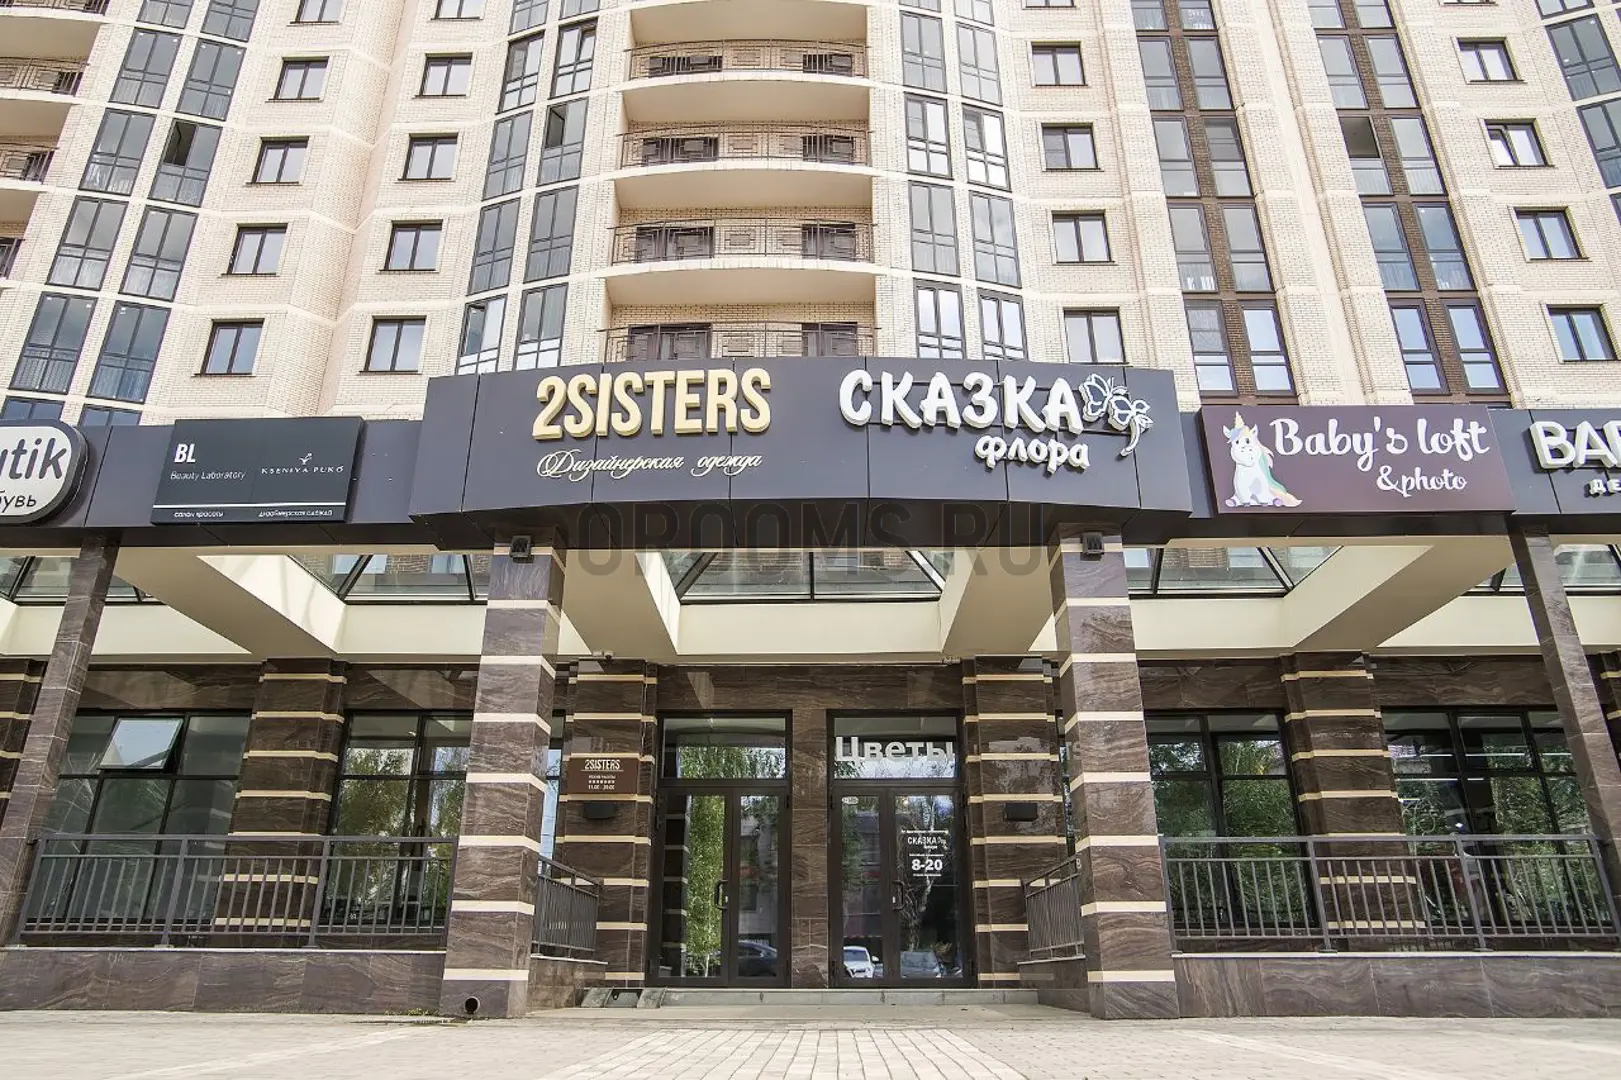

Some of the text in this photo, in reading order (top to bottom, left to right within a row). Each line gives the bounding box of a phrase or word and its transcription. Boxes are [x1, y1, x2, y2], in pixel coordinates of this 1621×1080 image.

[532, 368, 771, 440] 2SISTERS
[839, 369, 1084, 435] СКАЗКА
[0, 437, 67, 479] tik
[174, 443, 196, 463] BL
[974, 435, 1091, 474] флора
[1269, 416, 1490, 472] Baby's loft
[170, 471, 246, 481] Beauty Laboratory
[536, 449, 762, 482] Дизайнерская одежда
[1376, 465, 1468, 498] &photo
[584, 759, 621, 770] 2SISTERS
[835, 736, 956, 762] Цветы
[911, 858, 943, 871] 8-20
